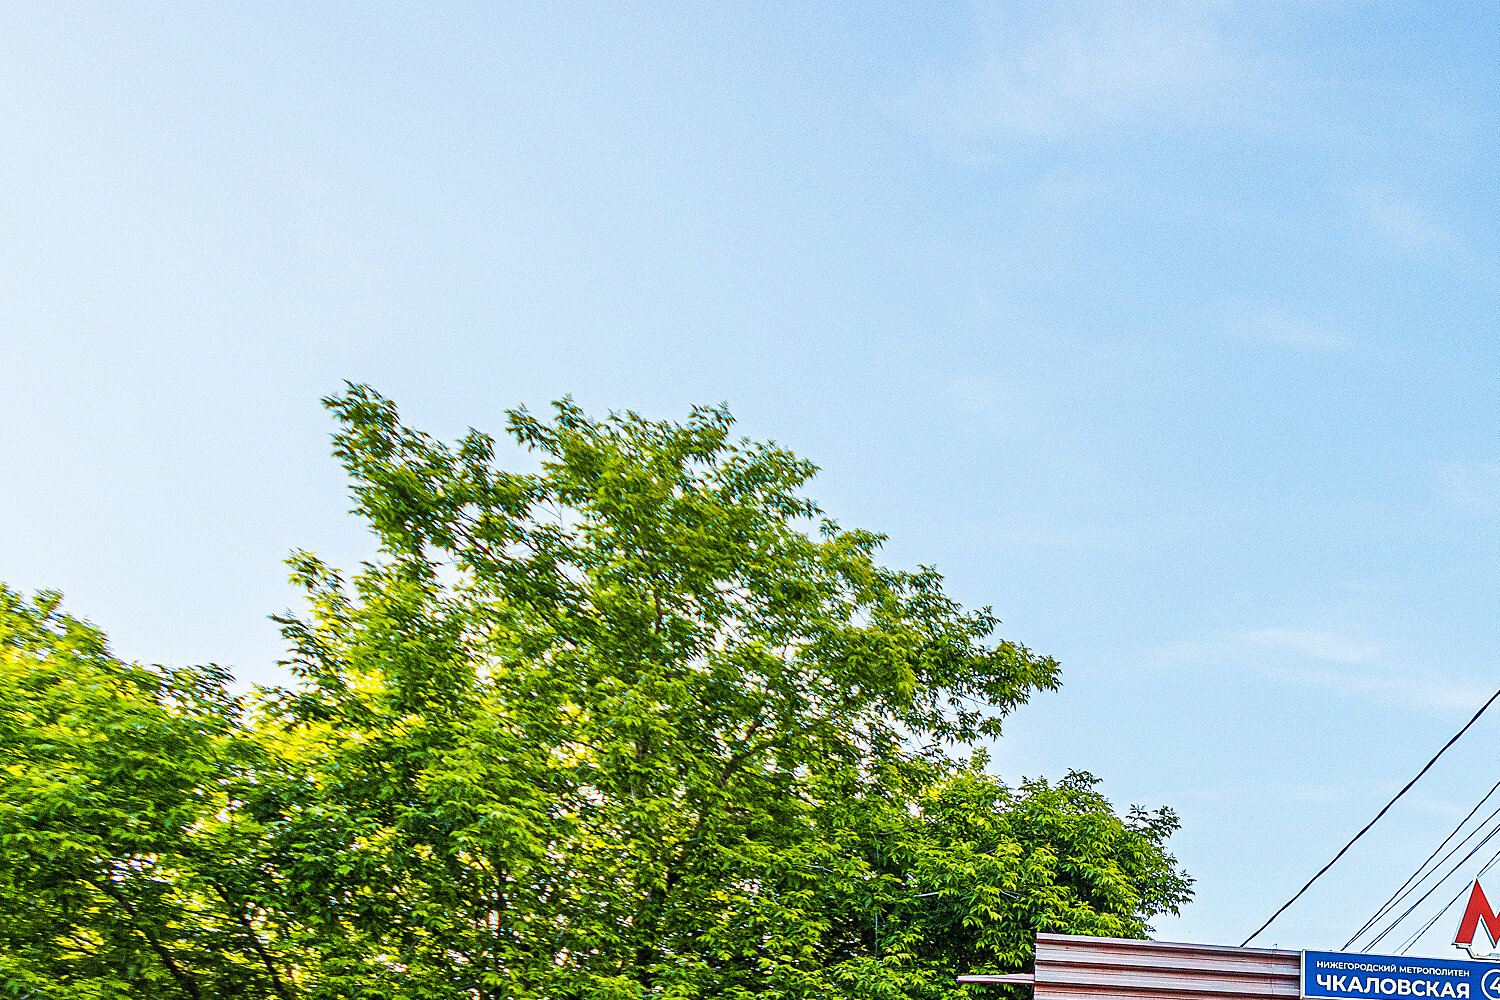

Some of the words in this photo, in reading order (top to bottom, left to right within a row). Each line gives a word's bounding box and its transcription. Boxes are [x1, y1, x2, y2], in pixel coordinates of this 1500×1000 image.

[1316, 960, 1397, 973] НИЖЕГОРОДСКИЙ
[1399, 966, 1470, 977] МЕТРОПОЛИТЕН
[1316, 974, 1470, 999] ЧКАЛОВСКАЯ
